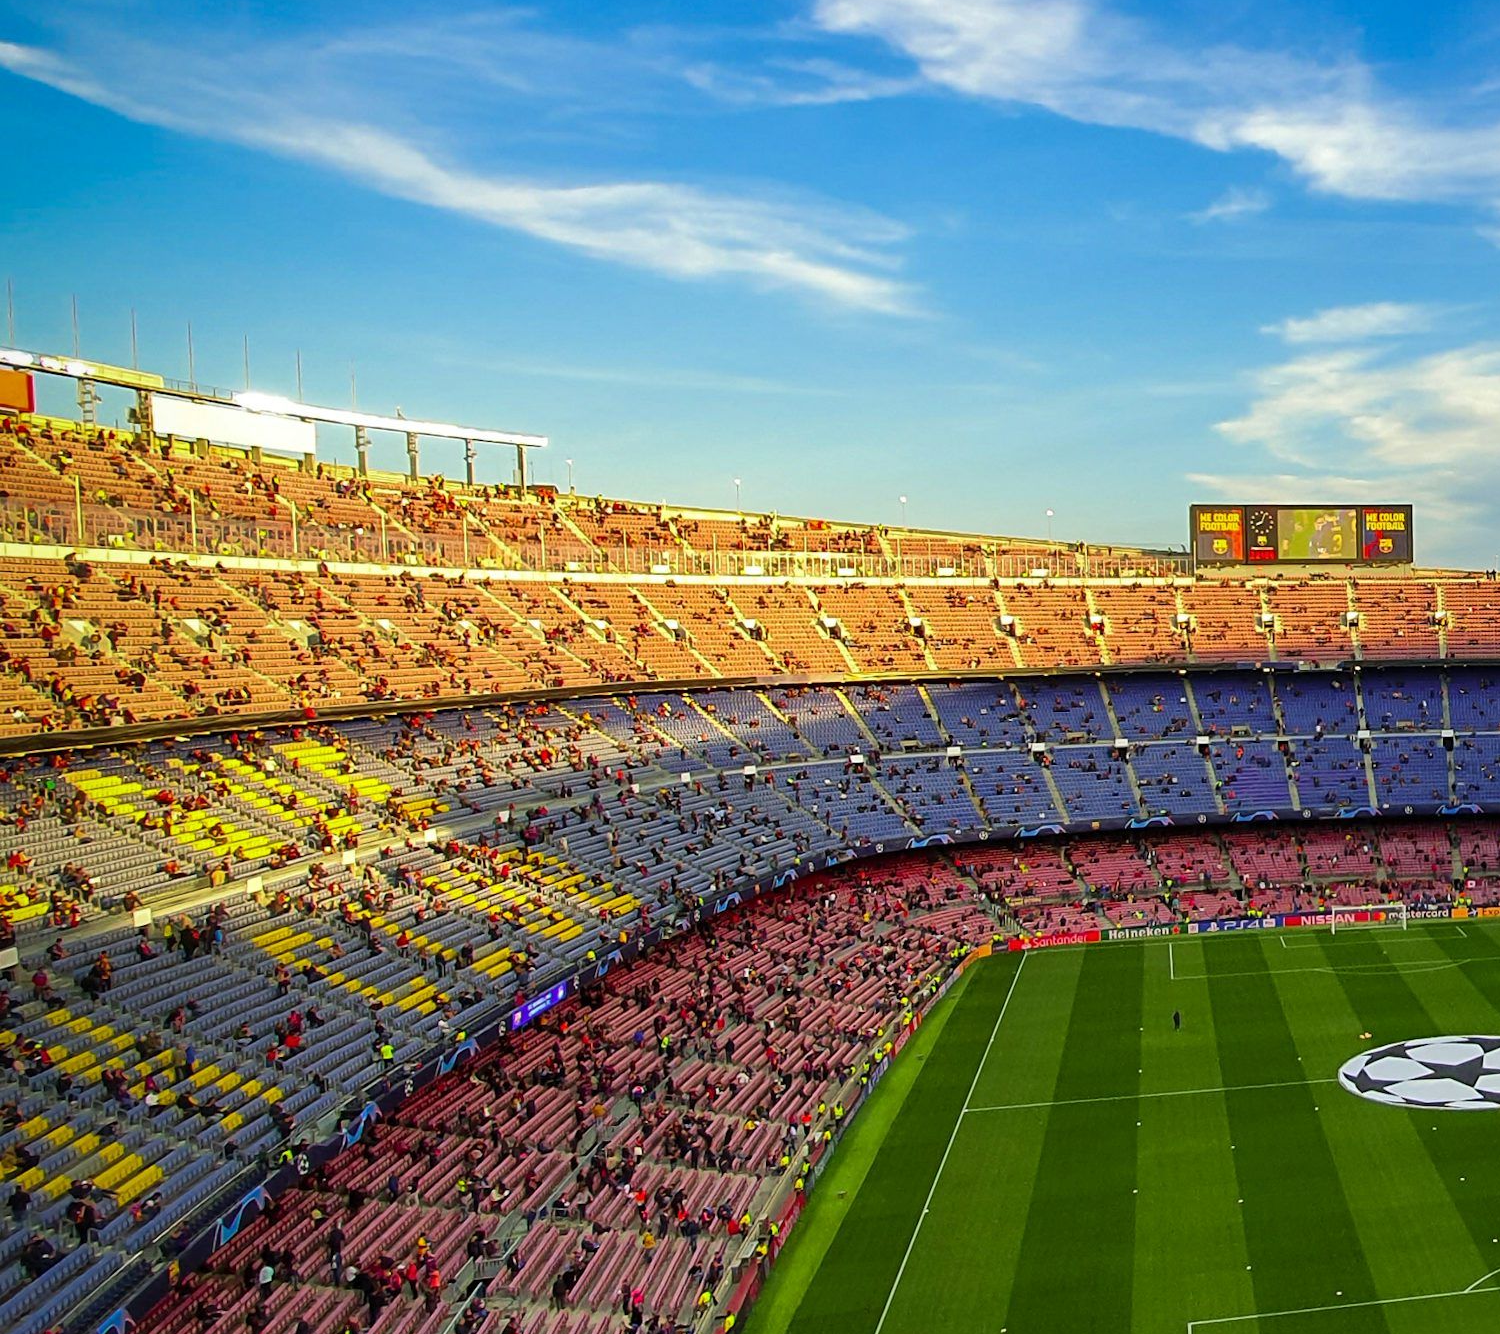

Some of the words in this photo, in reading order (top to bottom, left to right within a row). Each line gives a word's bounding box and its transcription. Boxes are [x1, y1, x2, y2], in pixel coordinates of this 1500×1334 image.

[1301, 913, 1355, 926] NISSAN
[1388, 908, 1449, 919] mastercard
[1224, 919, 1260, 931] PS4
[1108, 926, 1170, 940] Heineken
[1032, 932, 1088, 949] Santander
